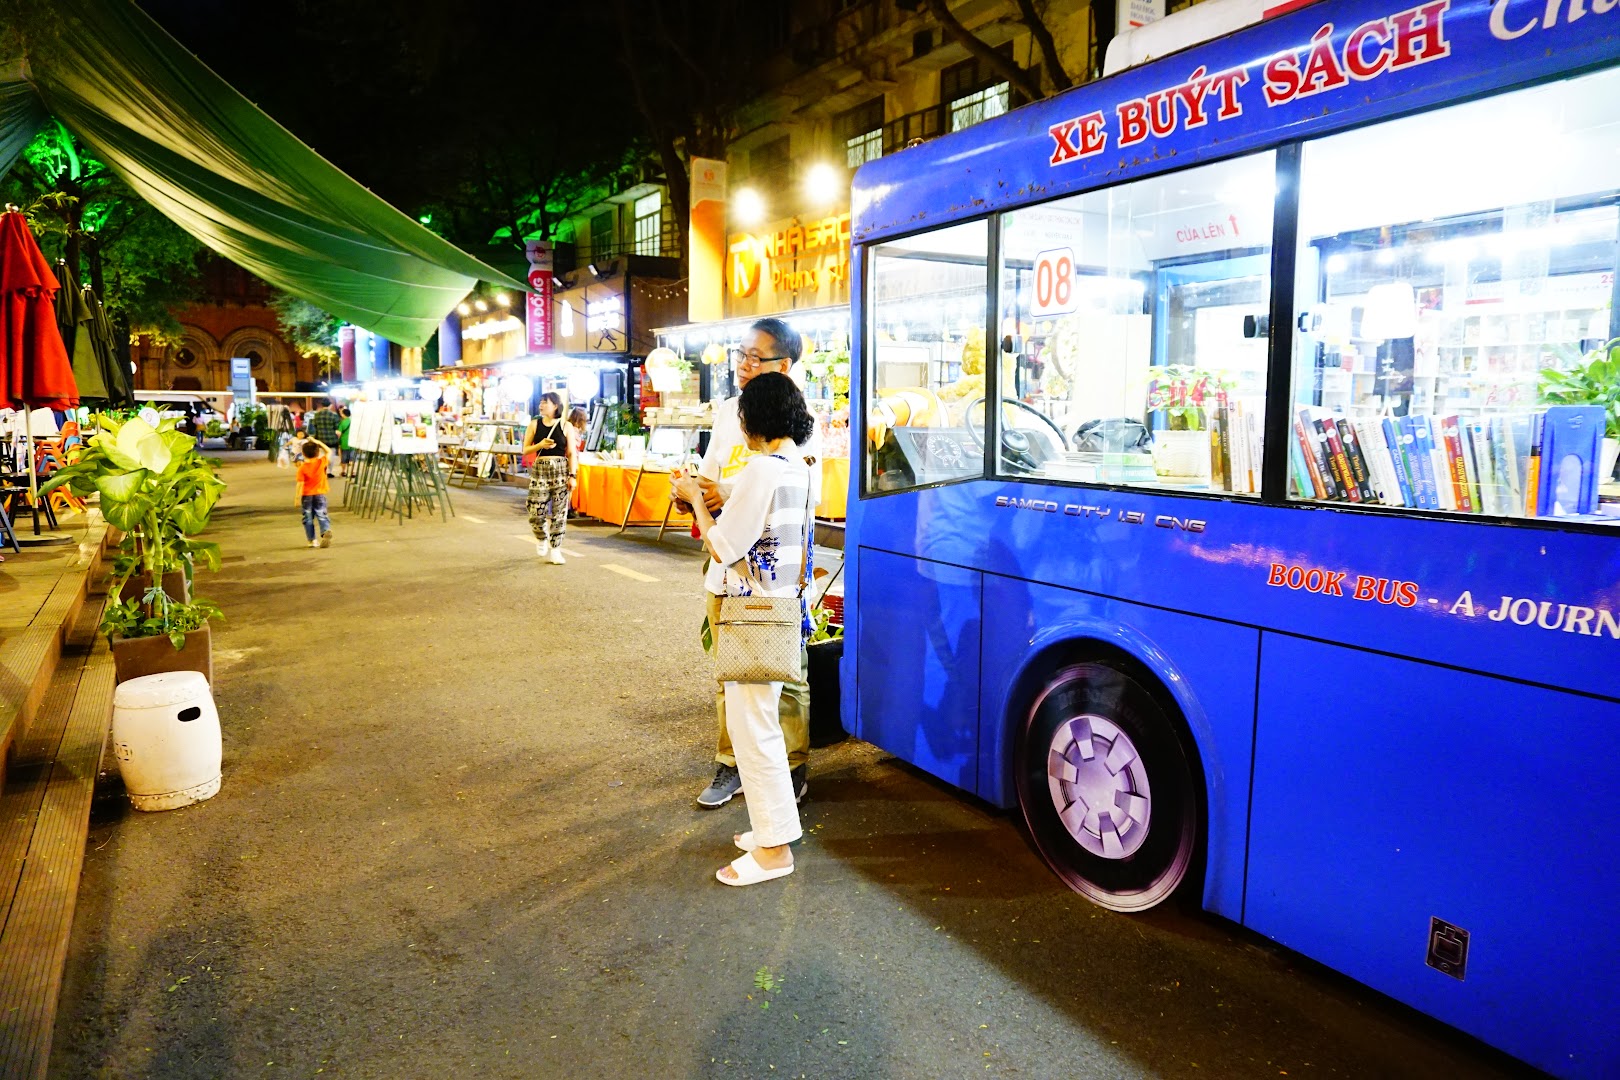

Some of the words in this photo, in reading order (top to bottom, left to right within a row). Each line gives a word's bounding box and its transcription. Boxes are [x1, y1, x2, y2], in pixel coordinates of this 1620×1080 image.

[1049, 110, 1108, 167] XE
[1117, 65, 1250, 149] BUÝT
[1262, 0, 1451, 108] SÁCH
[1037, 256, 1072, 308] 08
[533, 321, 545, 346] KIM
[995, 496, 1058, 513] SAMCO
[1064, 504, 1111, 519] CITY
[1155, 515, 1207, 533] CNG
[1267, 563, 1346, 596] BOOK
[1353, 575, 1419, 608] BUS
[1449, 590, 1475, 617] A
[1488, 595, 1620, 640] JOURN
